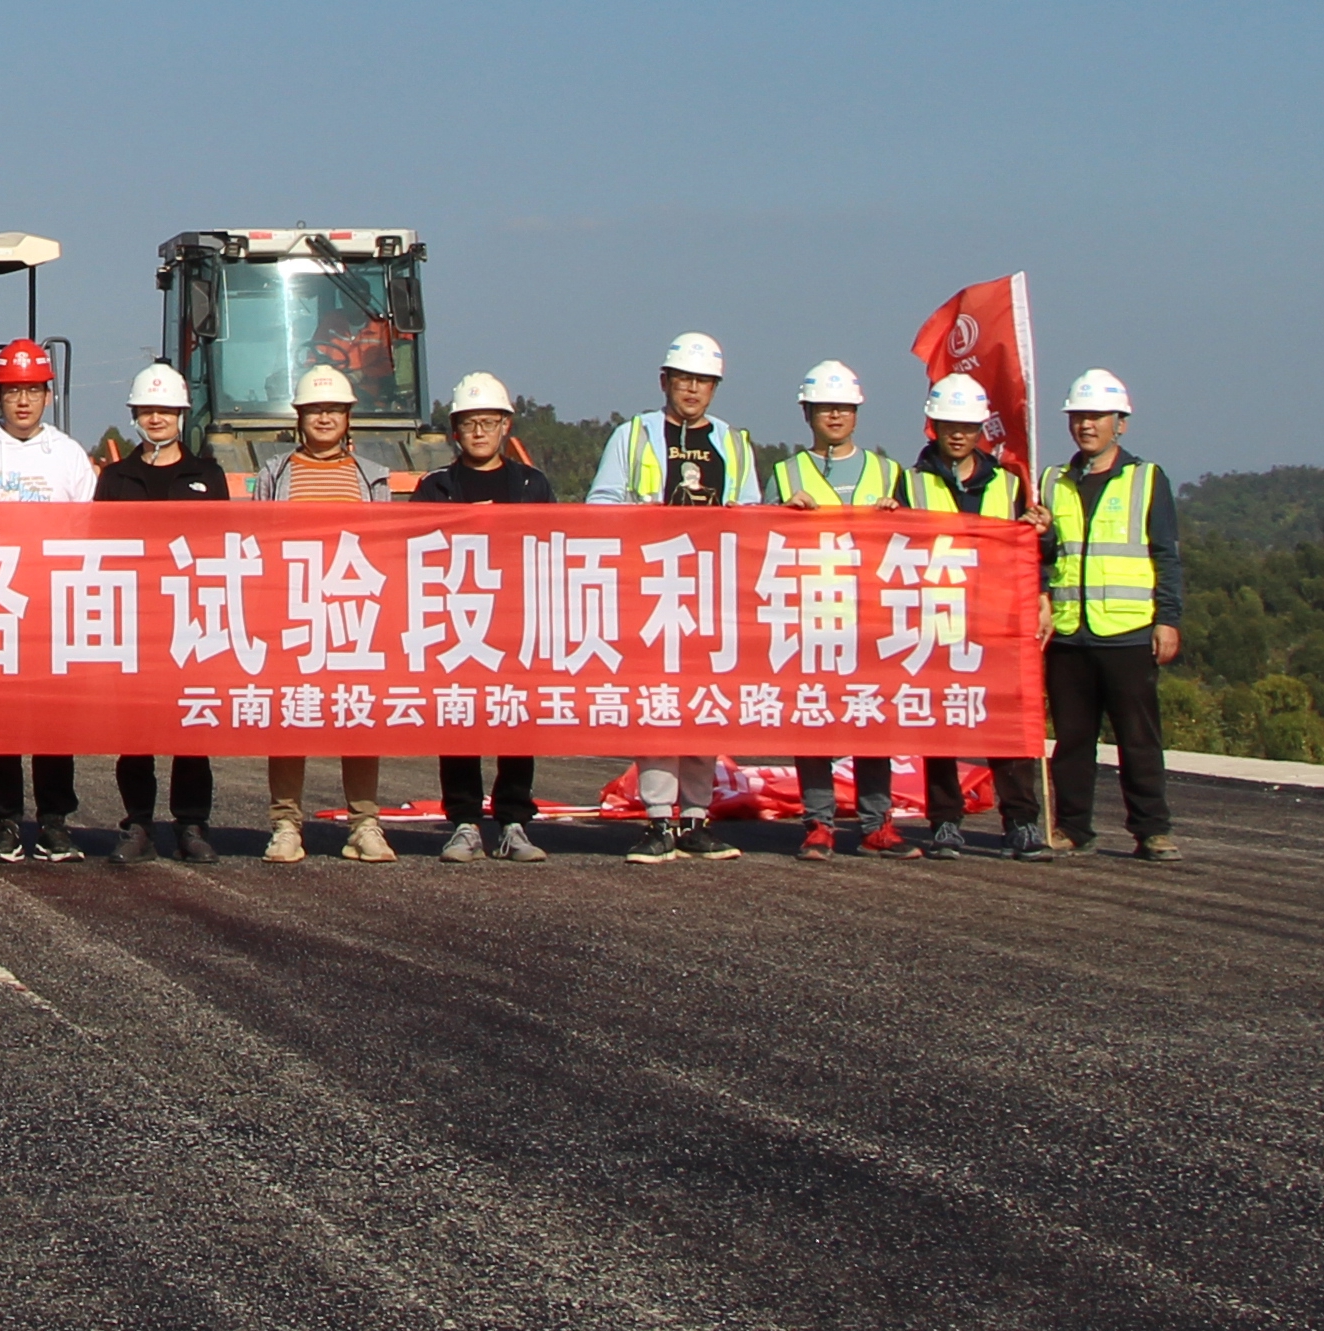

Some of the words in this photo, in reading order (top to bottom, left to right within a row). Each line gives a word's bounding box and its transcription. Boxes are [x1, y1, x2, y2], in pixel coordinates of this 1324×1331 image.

[177, 682, 987, 729] 云南建投云南弥玉高速公路总承包部
